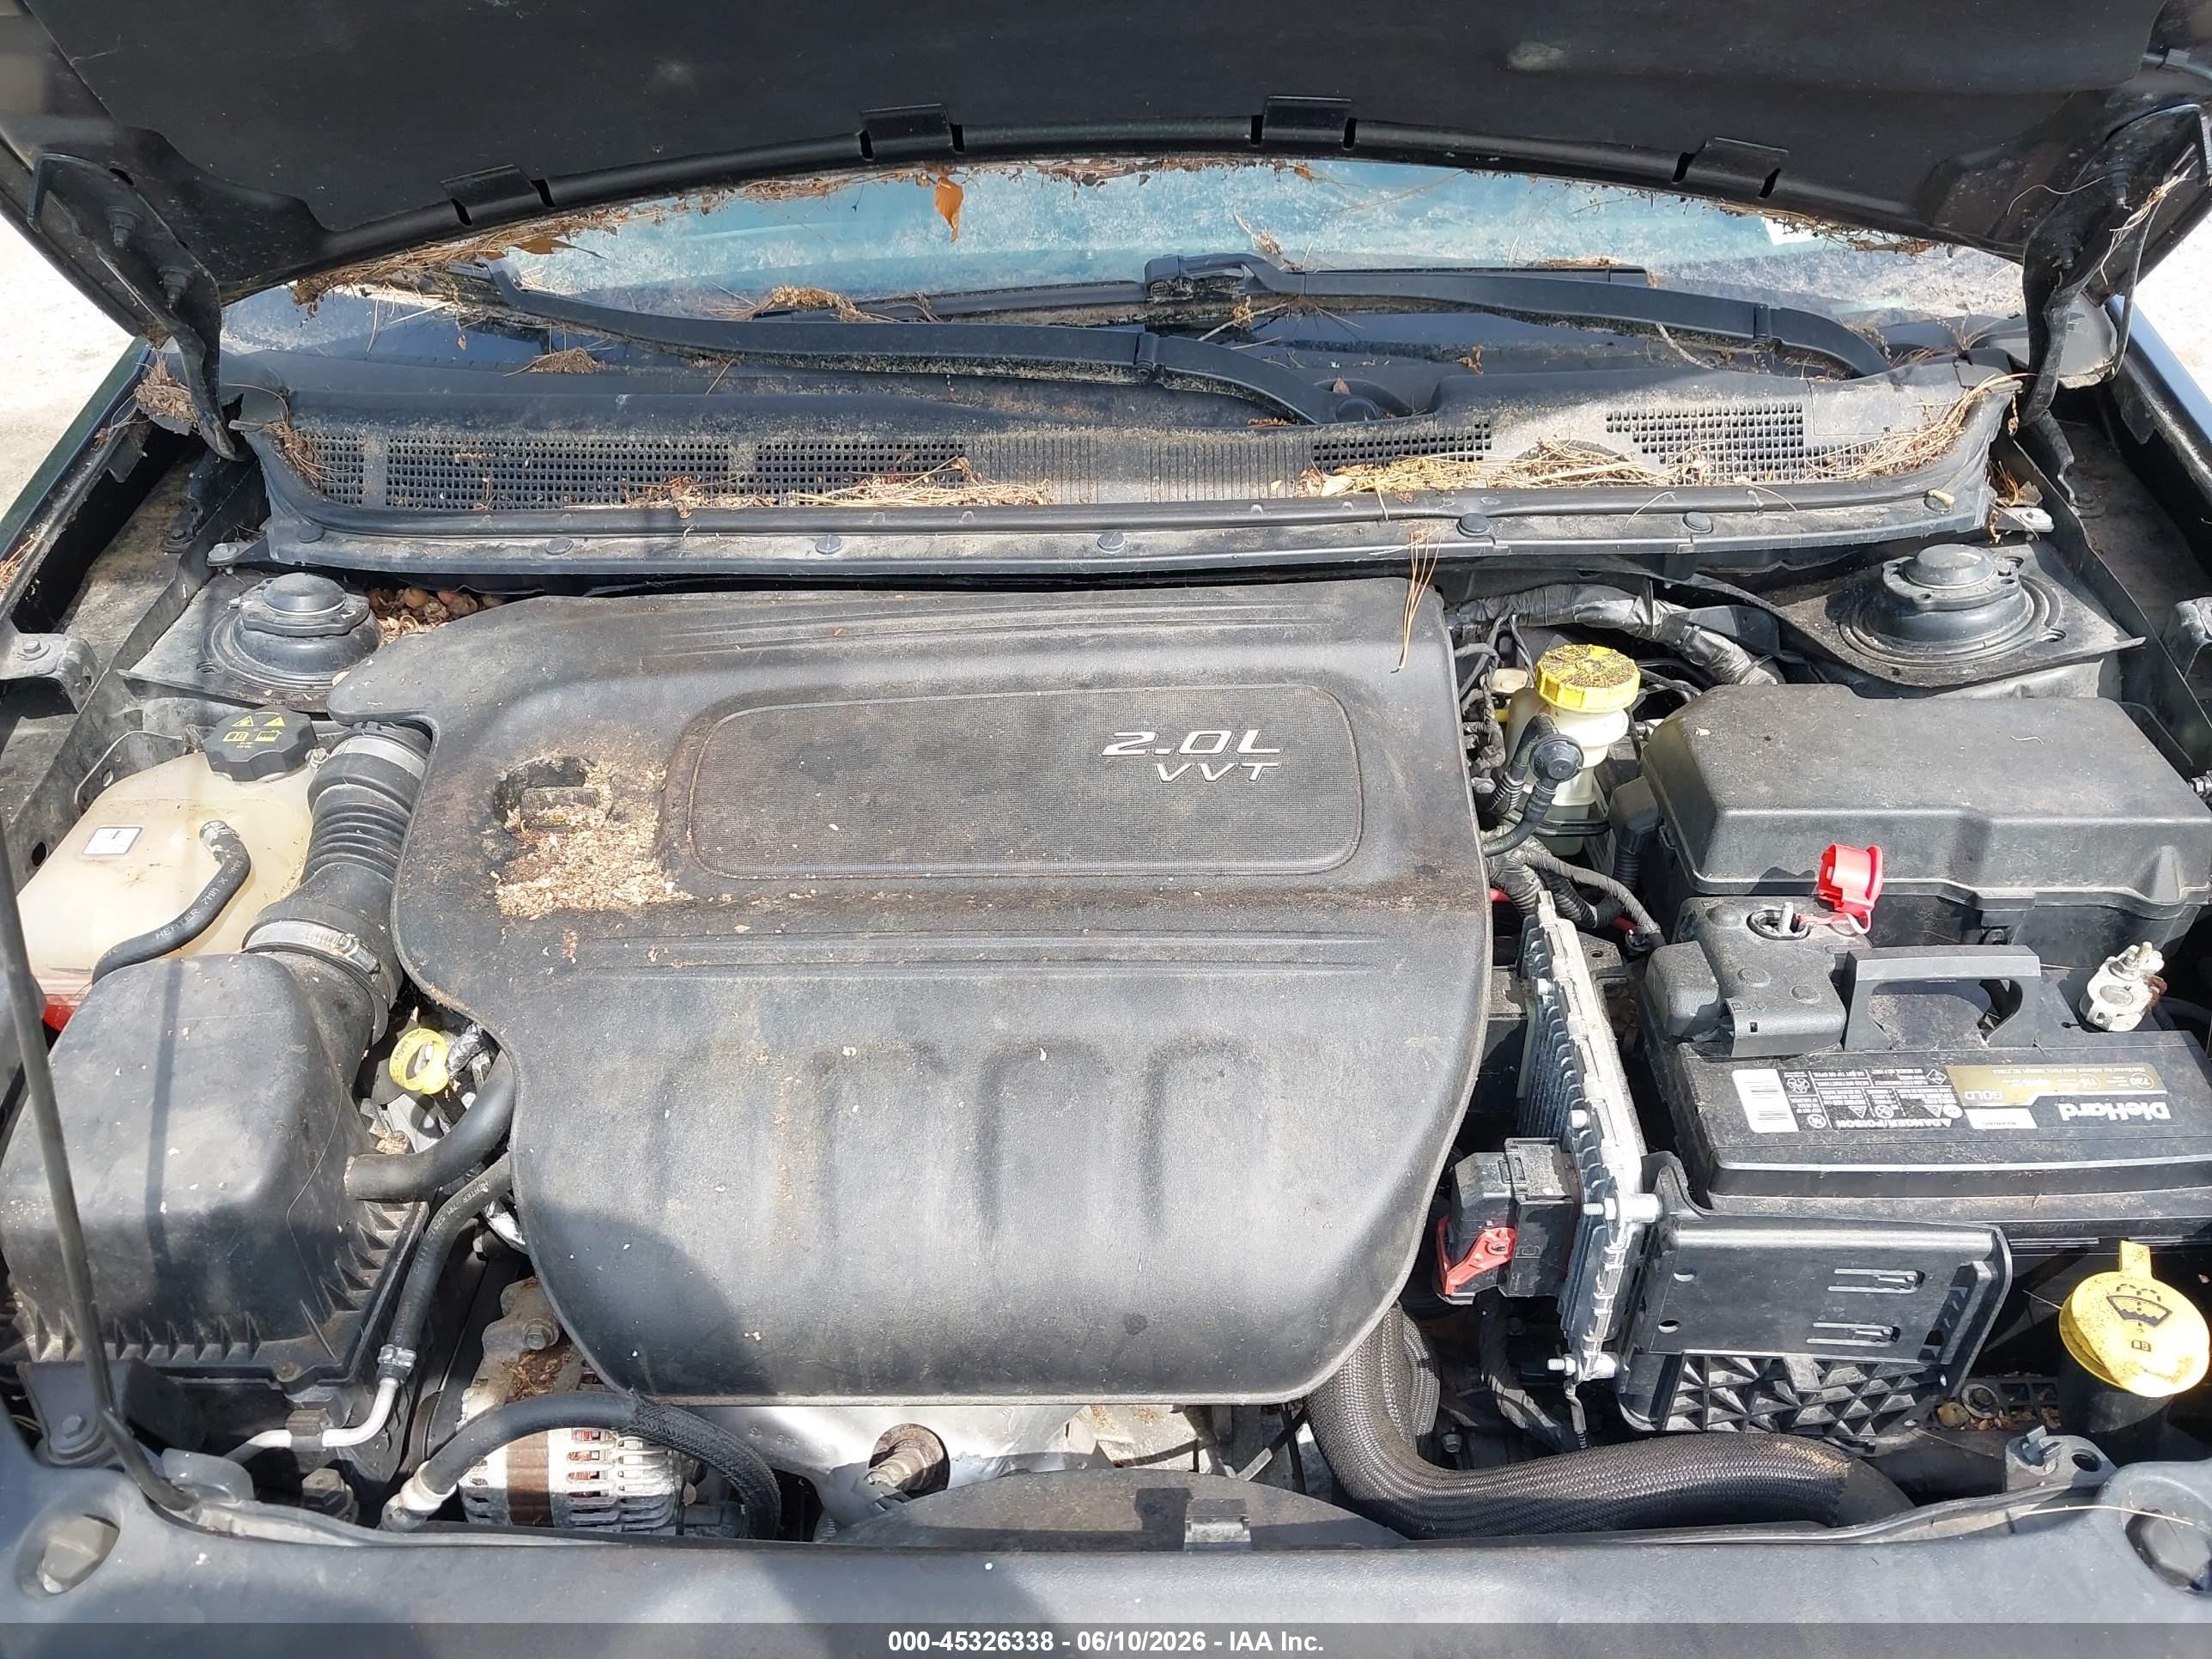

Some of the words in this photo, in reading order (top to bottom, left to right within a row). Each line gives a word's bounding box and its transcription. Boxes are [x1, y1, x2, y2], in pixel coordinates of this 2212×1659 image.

[1102, 729, 1284, 757] 2.0L
[1154, 763, 1283, 783] VVT
[155, 907, 201, 940] HEATER
[1965, 1090, 2002, 1101] GOLD
[2057, 1102, 2172, 1121] DieHard
